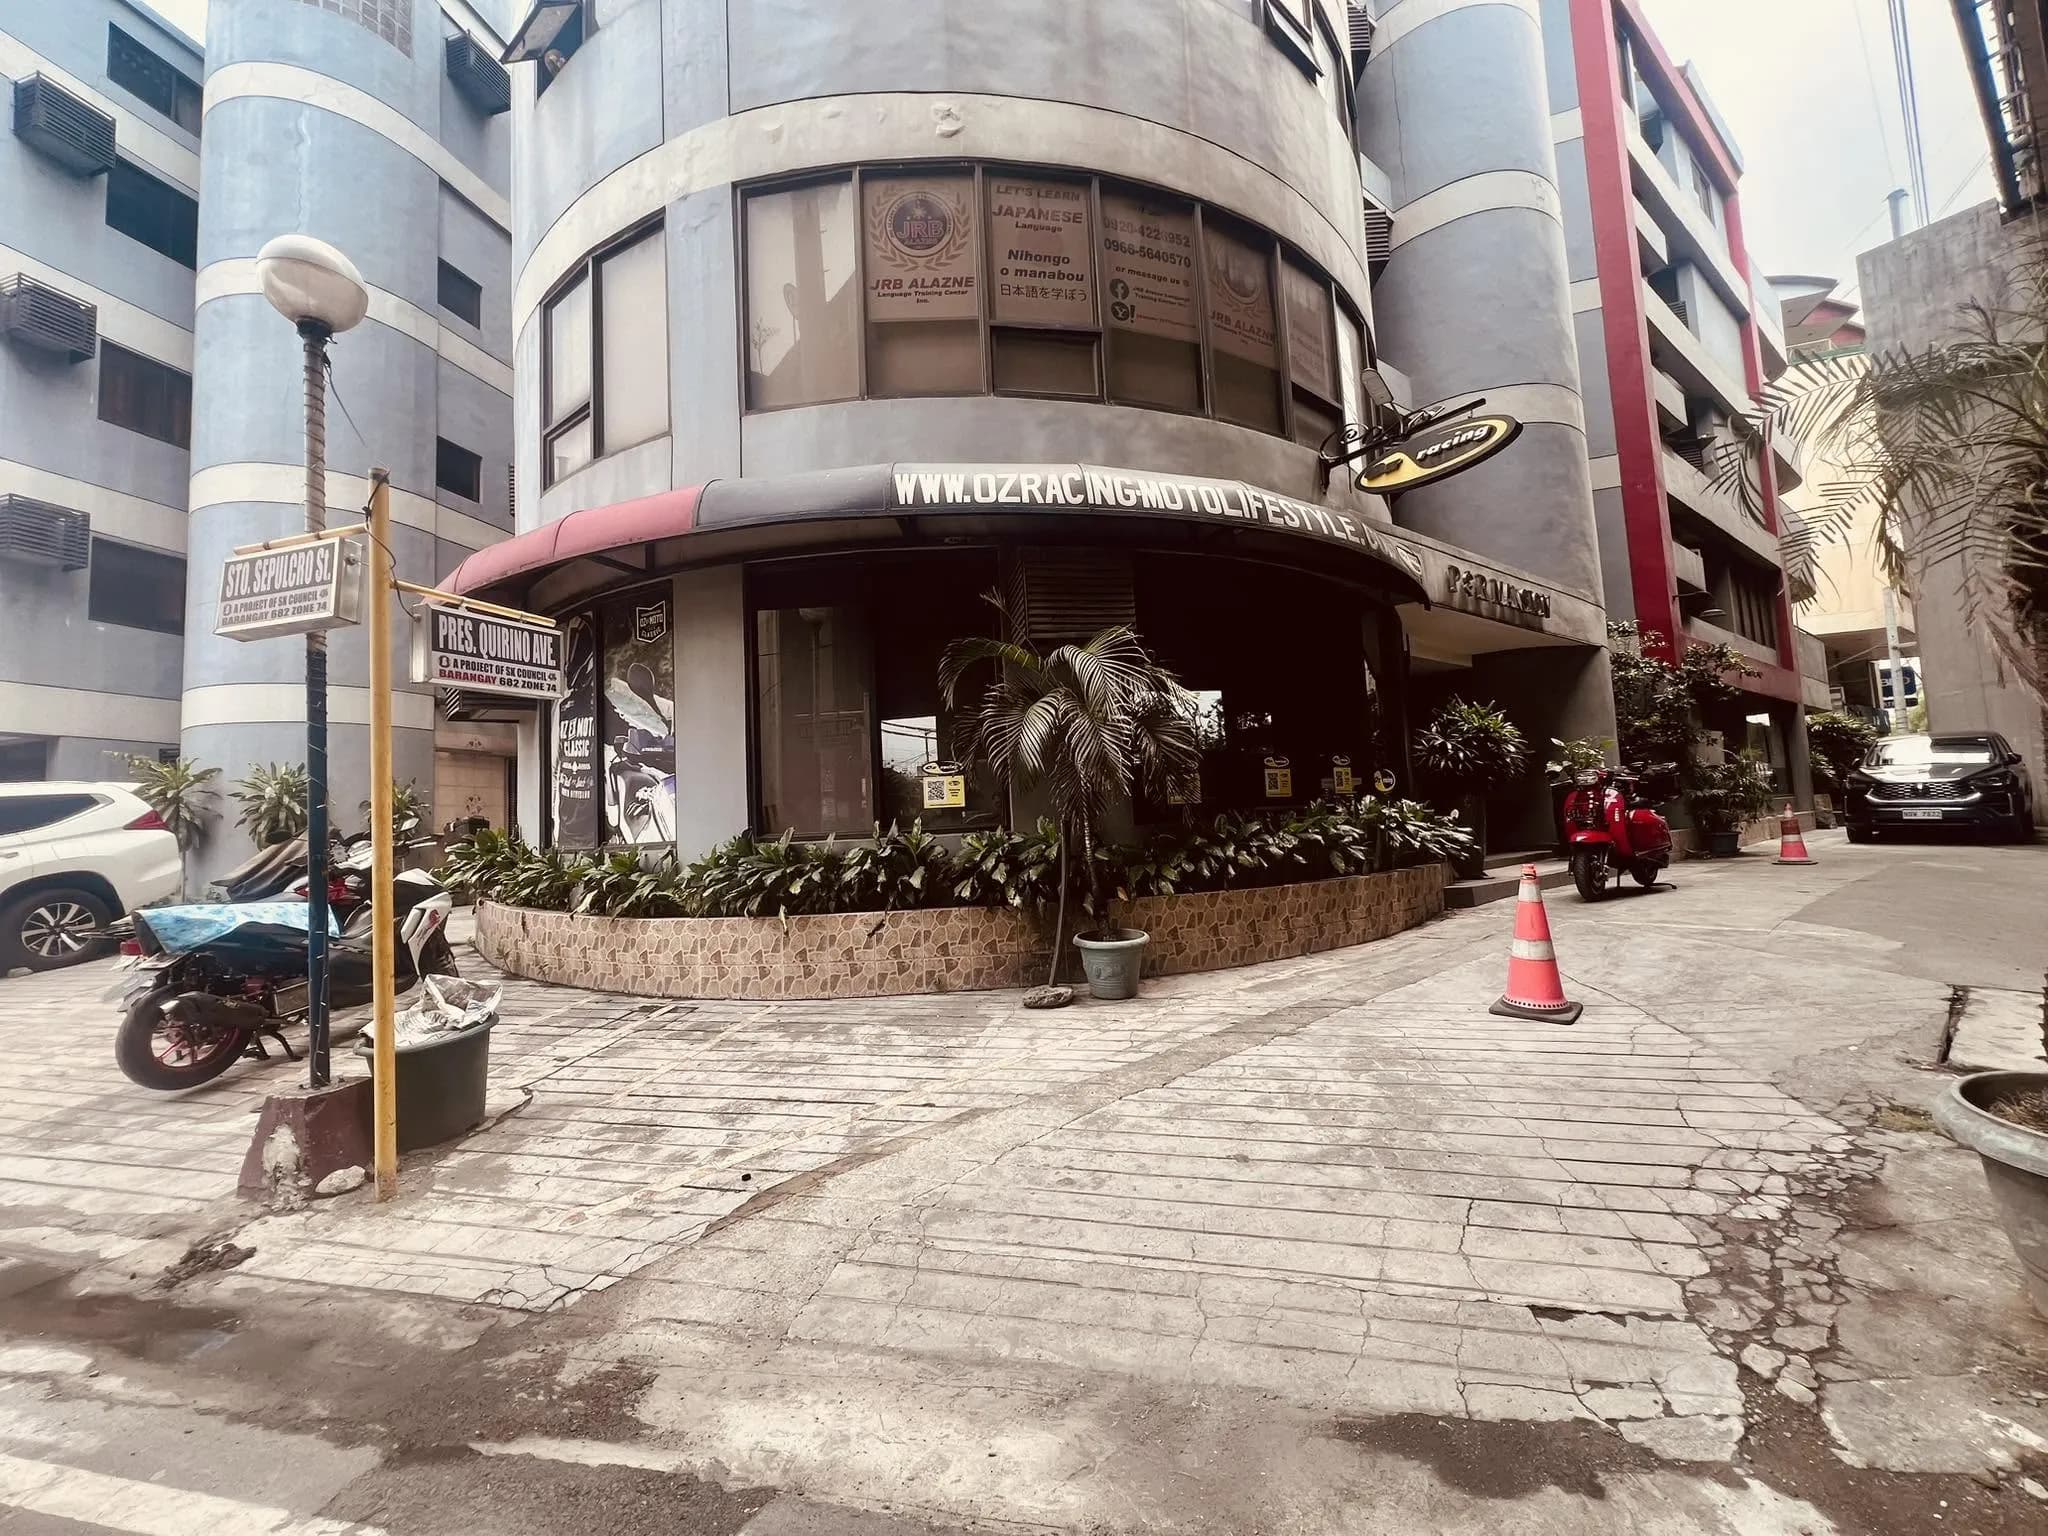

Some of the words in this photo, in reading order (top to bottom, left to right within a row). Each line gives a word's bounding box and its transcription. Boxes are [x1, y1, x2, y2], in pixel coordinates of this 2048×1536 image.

[996, 185, 1033, 197] LET'S
[1037, 188, 1080, 201] LEARN
[992, 204, 1083, 224] JAPANESE
[896, 220, 945, 238] JRB
[1015, 221, 1063, 233] Language
[1007, 249, 1070, 266] Nihongo
[870, 279, 903, 290] JRB
[908, 276, 975, 289] ALAZNE
[1000, 267, 1009, 276] o
[1014, 268, 1084, 282] manabou
[1127, 268, 1168, 282] message
[1000, 284, 1087, 302] 日本語を学ぼう
[1209, 309, 1232, 326] JRB
[1416, 425, 1491, 461] racing
[226, 562, 250, 598] STO.
[253, 550, 314, 594] SEPULCRO
[315, 548, 331, 582] St.
[233, 604, 239, 614] A
[240, 600, 267, 613] PROJECT
[269, 598, 278, 609] OF
[279, 596, 287, 606] SK
[289, 591, 318, 606] COUNCIL
[222, 611, 270, 626] BARANGAY
[271, 607, 290, 619] 682
[292, 604, 314, 616] ZONE
[316, 602, 328, 612] 74
[438, 614, 477, 654] PRES.
[479, 622, 531, 660] QUIRINO
[453, 658, 459, 669] A
[461, 660, 493, 674] PROJECT
[495, 664, 504, 675] OF
[505, 666, 516, 677] SK
[517, 668, 547, 682] COUNCIL
[439, 669, 497, 685] BARANGAY
[499, 677, 519, 689] 682
[521, 680, 545, 692] ZONE
[546, 683, 557, 693] 74
